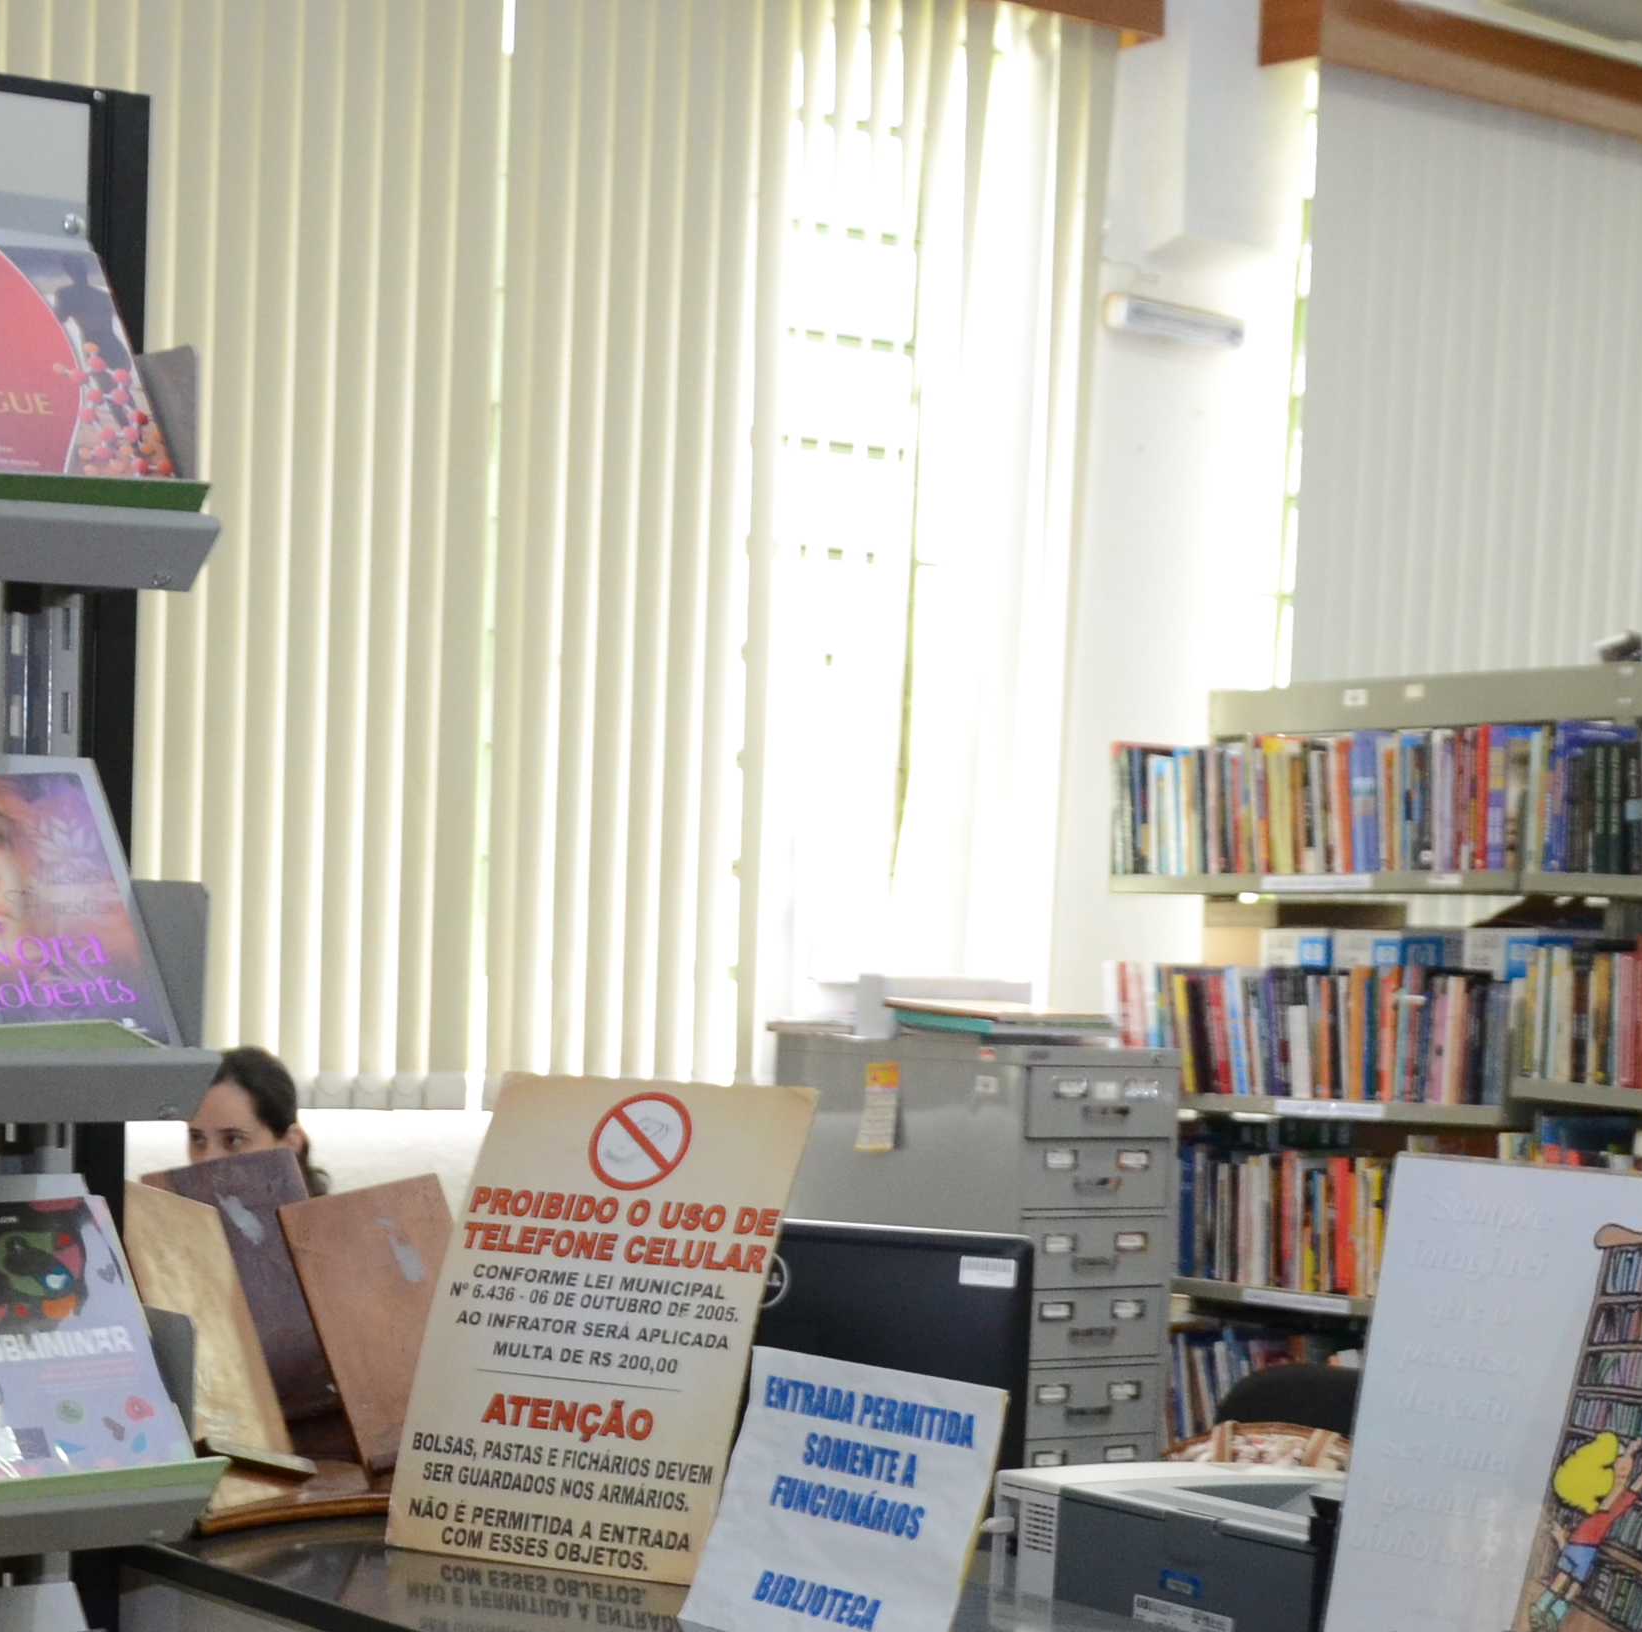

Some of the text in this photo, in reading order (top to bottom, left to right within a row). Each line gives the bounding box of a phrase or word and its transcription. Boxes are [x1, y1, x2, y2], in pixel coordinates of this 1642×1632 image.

[469, 1187, 781, 1237] PROIBIDO O USO DE
[464, 1222, 768, 1273] TELEFONE CELULAR
[472, 1283, 515, 1302] 6.436
[529, 1289, 550, 1304] 06
[554, 1291, 576, 1307] DE
[580, 1293, 660, 1316] OUTUBRO
[667, 1301, 690, 1318] DE
[695, 1302, 740, 1323] 2005.
[473, 1264, 726, 1300] CONFORME LEI MUNICIPAL
[456, 1310, 729, 1350] AO INFRATOR SERÁ APLICADA
[493, 1341, 679, 1375] MULTA DE 200,00
[481, 1393, 654, 1442] ATENÇÃO
[763, 1374, 976, 1450] ENTRADA PERMITIDA
[412, 1433, 713, 1485] BOLSAS, PASTAS E FICHÁRIOS DEVEM
[802, 1432, 919, 1489] SOMENTE A
[422, 1462, 689, 1513] SER GUARDADOS NOS ARMÁRIOS.
[768, 1474, 927, 1541] FUNCIONÁRIOS
[409, 1496, 690, 1552] NÃO É PERMITIDA A ENTRADA
[442, 1527, 649, 1572] COM ESSES OBJETOS.
[752, 1570, 883, 1632] BIBLIOTECA
